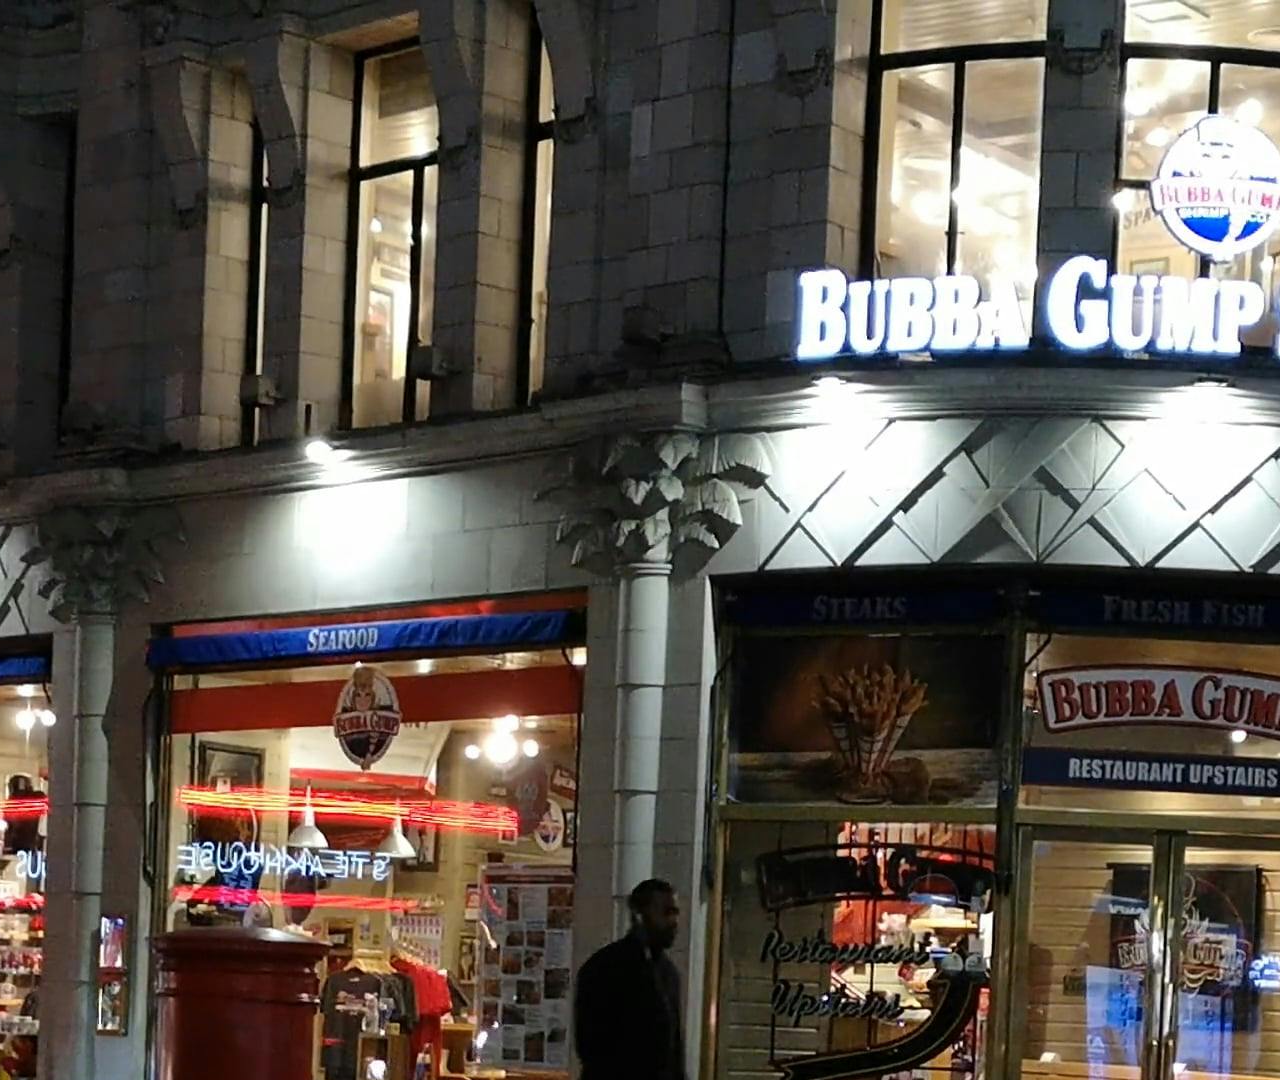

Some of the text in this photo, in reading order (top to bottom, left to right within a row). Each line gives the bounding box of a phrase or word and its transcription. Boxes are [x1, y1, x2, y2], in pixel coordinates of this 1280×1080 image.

[1160, 185, 1225, 205] BUBBA
[797, 268, 1031, 359] BUBBA
[1048, 256, 1264, 354] GUMP
[813, 595, 907, 621] STEAKS
[1103, 595, 1264, 627] FRESH FISH
[307, 627, 378, 651] SEAFOOD
[1050, 678, 1185, 723] BUBBA
[1069, 758, 1278, 788] RESTAURANT UPSTAIRS
[759, 928, 931, 964] Restaurant
[772, 978, 906, 1028] Upstairs
